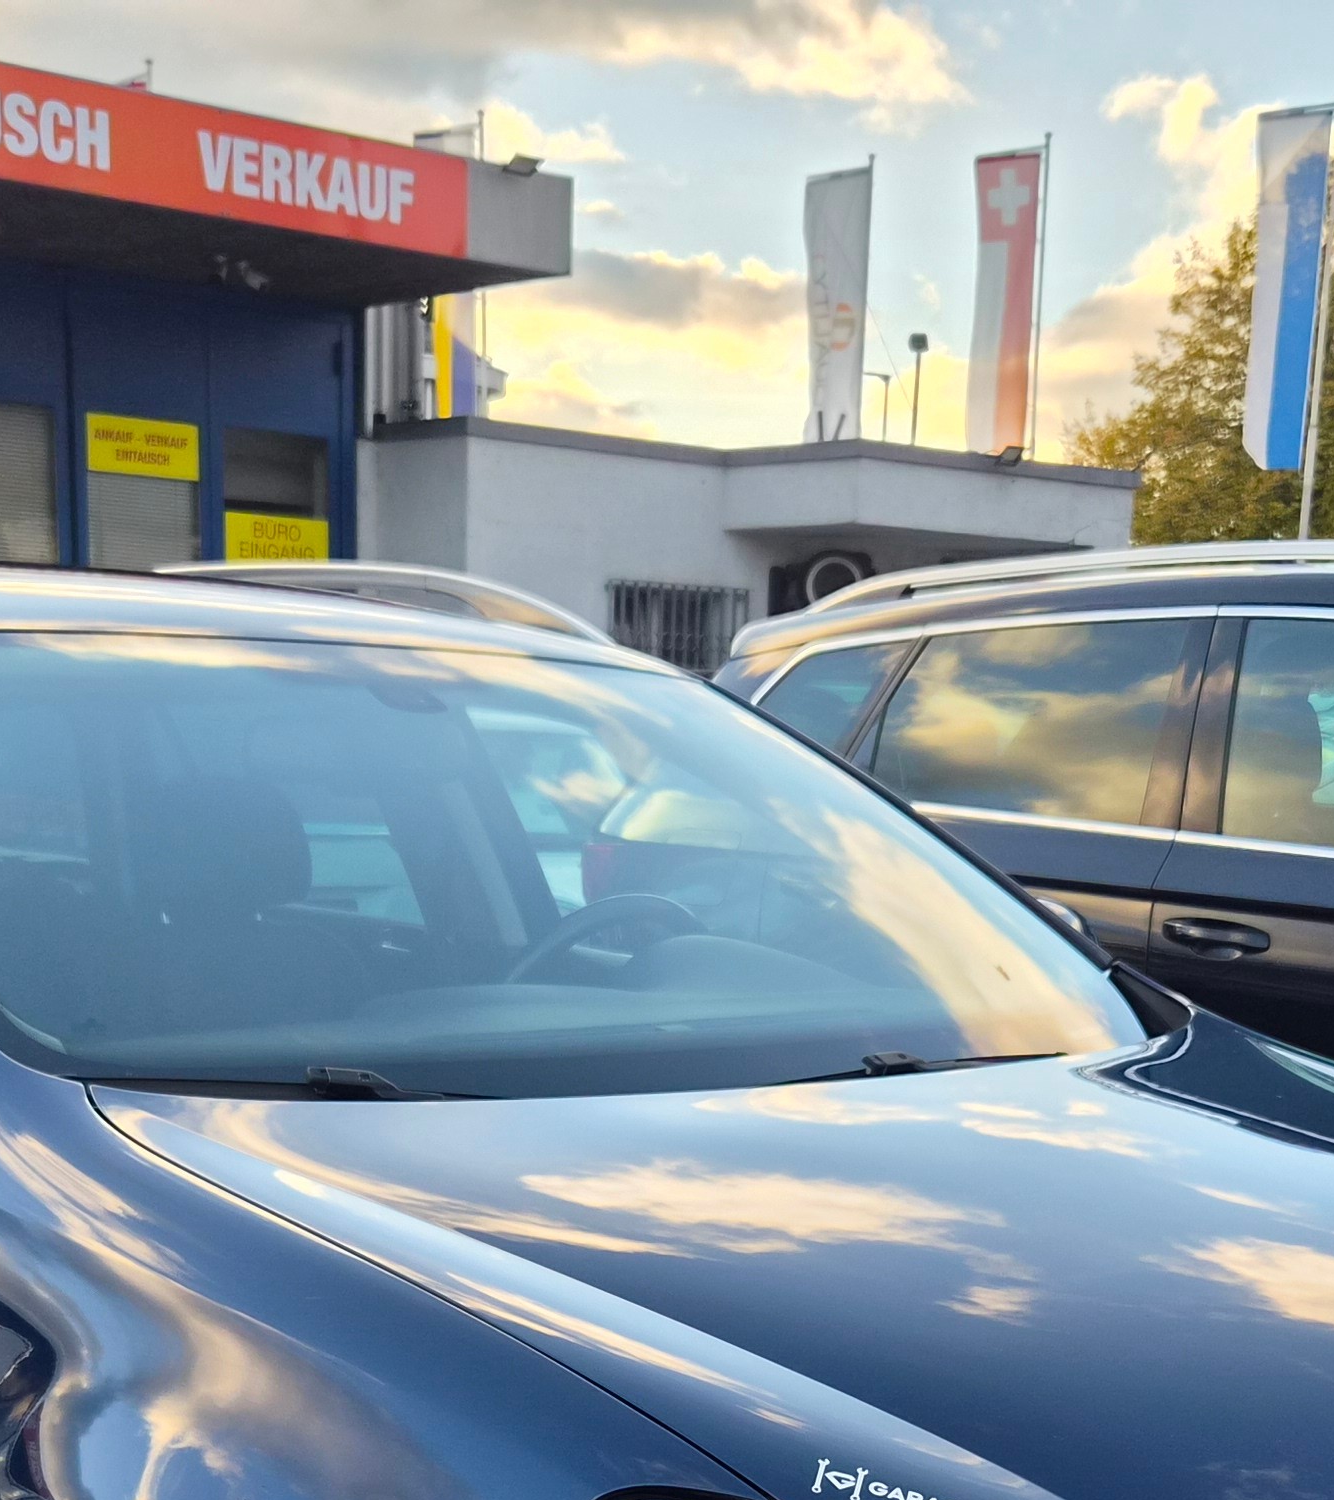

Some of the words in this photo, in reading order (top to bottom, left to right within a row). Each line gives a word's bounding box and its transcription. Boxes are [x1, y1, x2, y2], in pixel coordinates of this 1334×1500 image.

[198, 129, 415, 226] VERKAUF
[94, 428, 134, 444] ANKAUF
[144, 433, 189, 449] VERKAUF
[115, 448, 171, 467] EINTAUSCH
[253, 519, 301, 542] BÜRO
[239, 541, 315, 560] EINGANG
